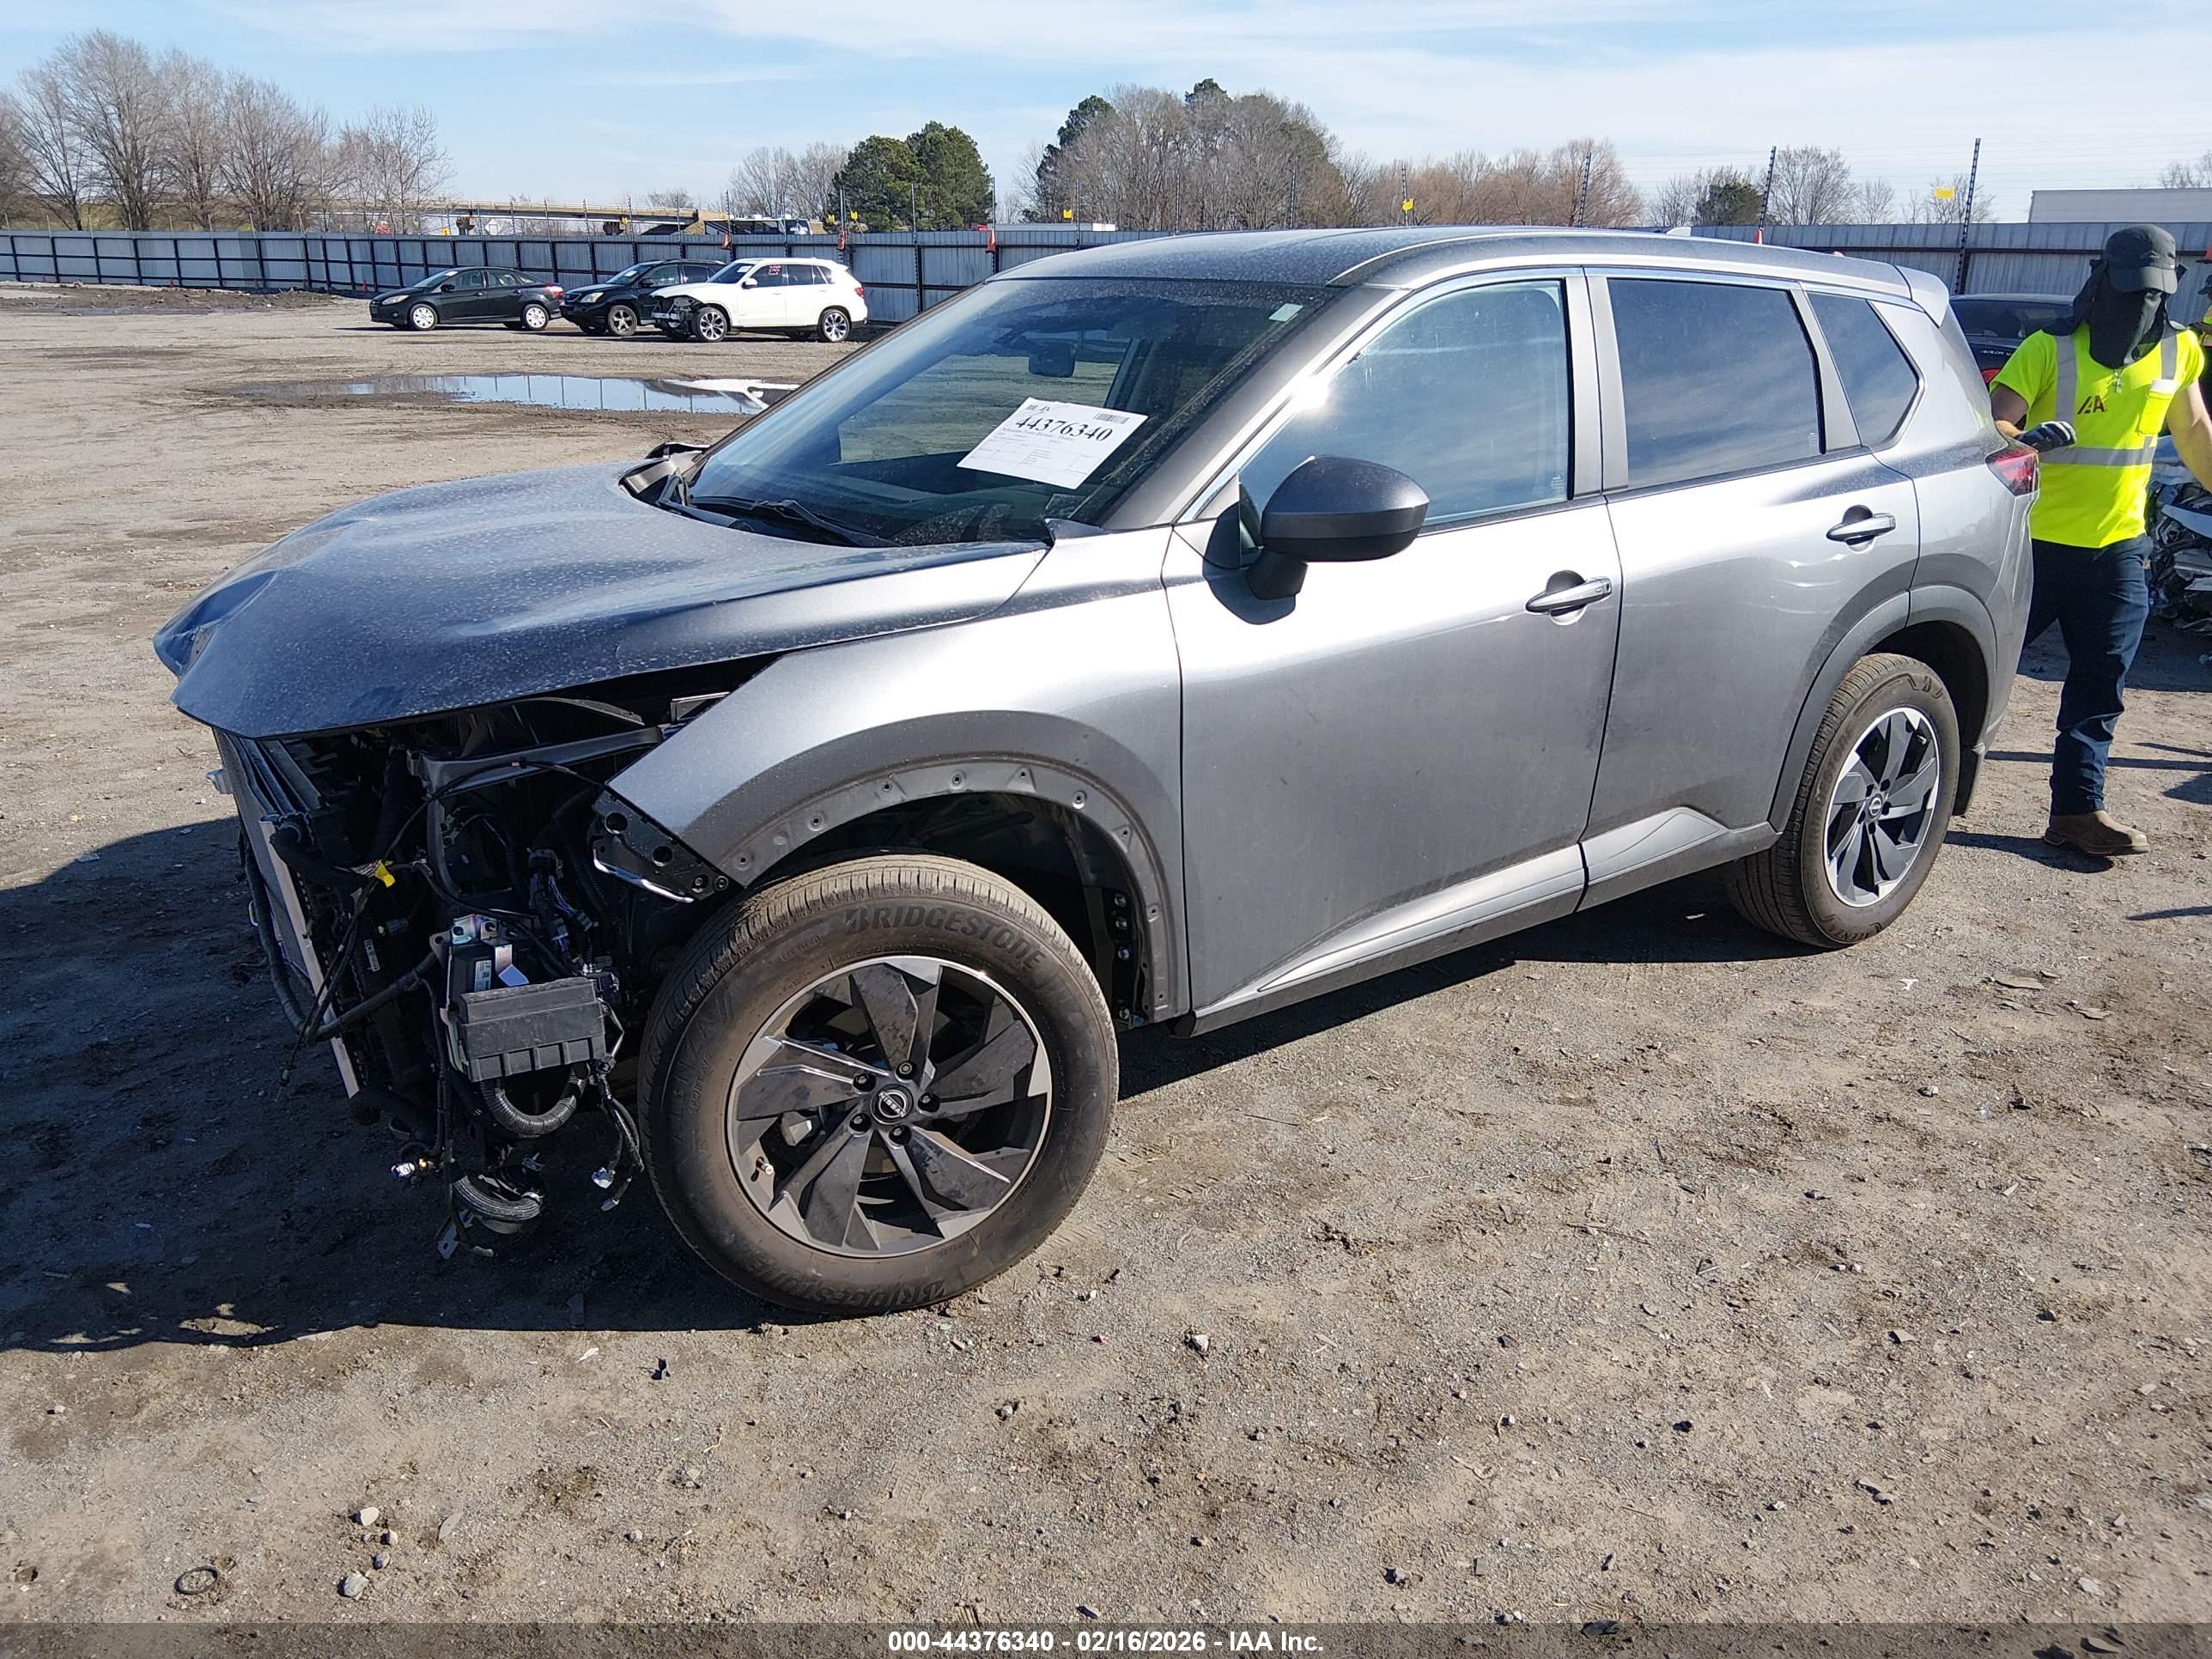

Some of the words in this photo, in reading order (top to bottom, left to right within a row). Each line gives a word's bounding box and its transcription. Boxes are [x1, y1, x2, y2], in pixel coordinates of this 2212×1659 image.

[1016, 416, 1113, 441] 44376340
[844, 905, 1048, 970] BRIDGESTONE
[878, 1091, 906, 1118] NISSAN
